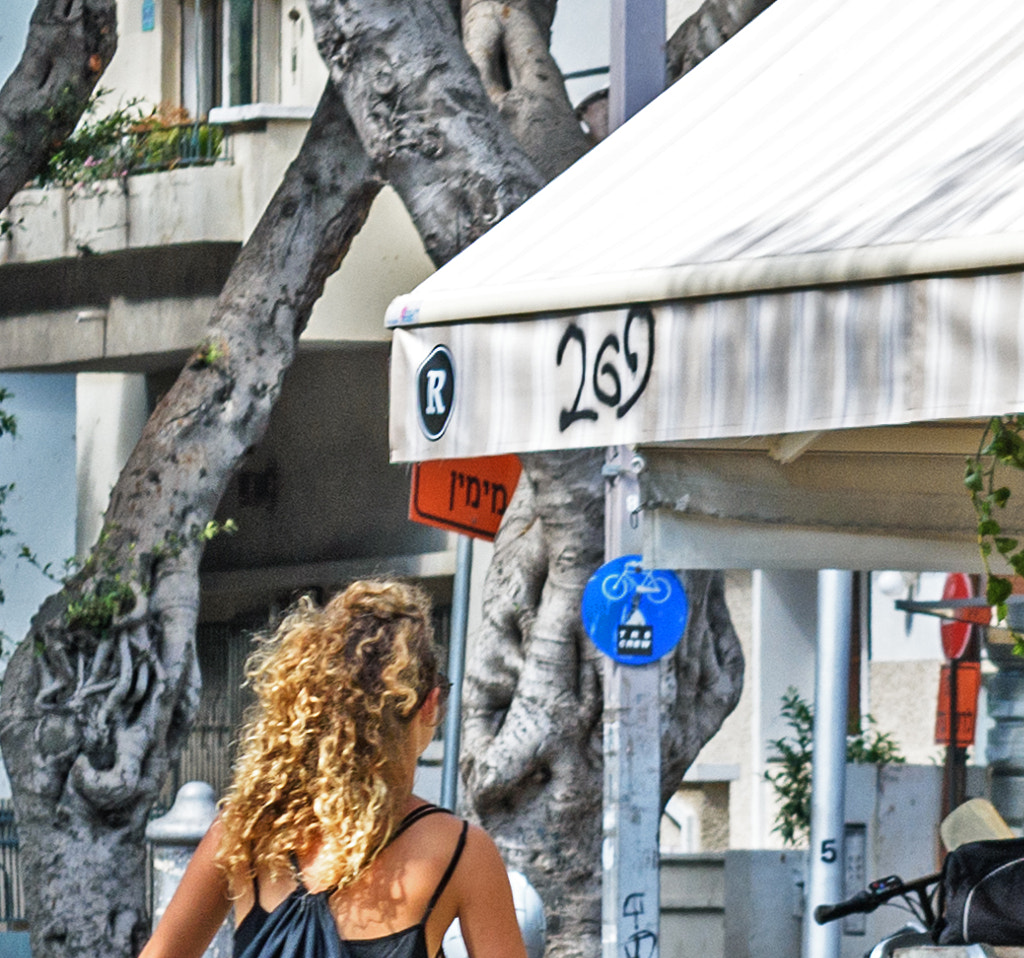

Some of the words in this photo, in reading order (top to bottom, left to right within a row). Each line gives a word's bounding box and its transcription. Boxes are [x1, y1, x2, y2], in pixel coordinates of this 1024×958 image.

[425, 369, 447, 415] R
[556, 306, 656, 434] 269
[449, 470, 507, 516] מימין
[820, 838, 837, 864] 5
